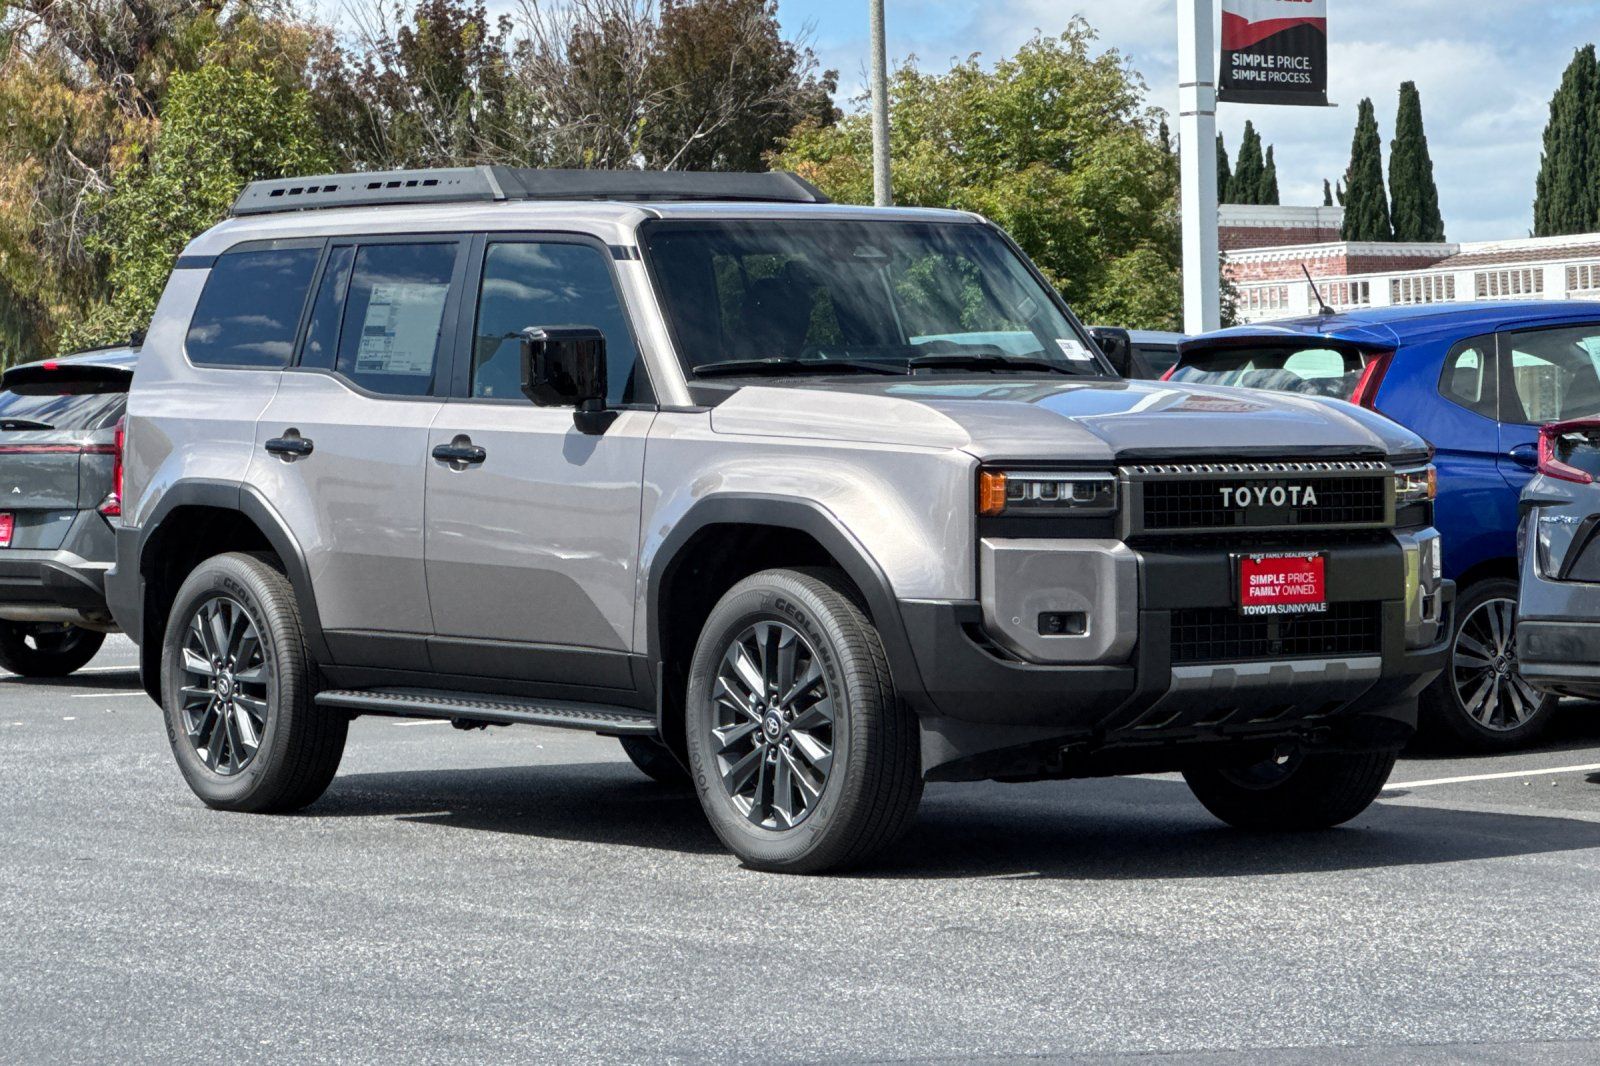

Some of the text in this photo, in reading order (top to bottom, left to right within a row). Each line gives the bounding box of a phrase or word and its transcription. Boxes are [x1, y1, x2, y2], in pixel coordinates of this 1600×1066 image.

[1232, 53, 1312, 70] SIMPLE PRICE.
[1232, 69, 1312, 83] SIMPLE PROCESS.
[1219, 486, 1318, 508] TOYOTA
[1249, 572, 1317, 585] SIMPLE PRICE.
[1249, 584, 1317, 597] FAMILY OWNED.
[1243, 603, 1327, 615] TOYOTA SUNNYVALE
[774, 597, 844, 719] GEOLANDAR
